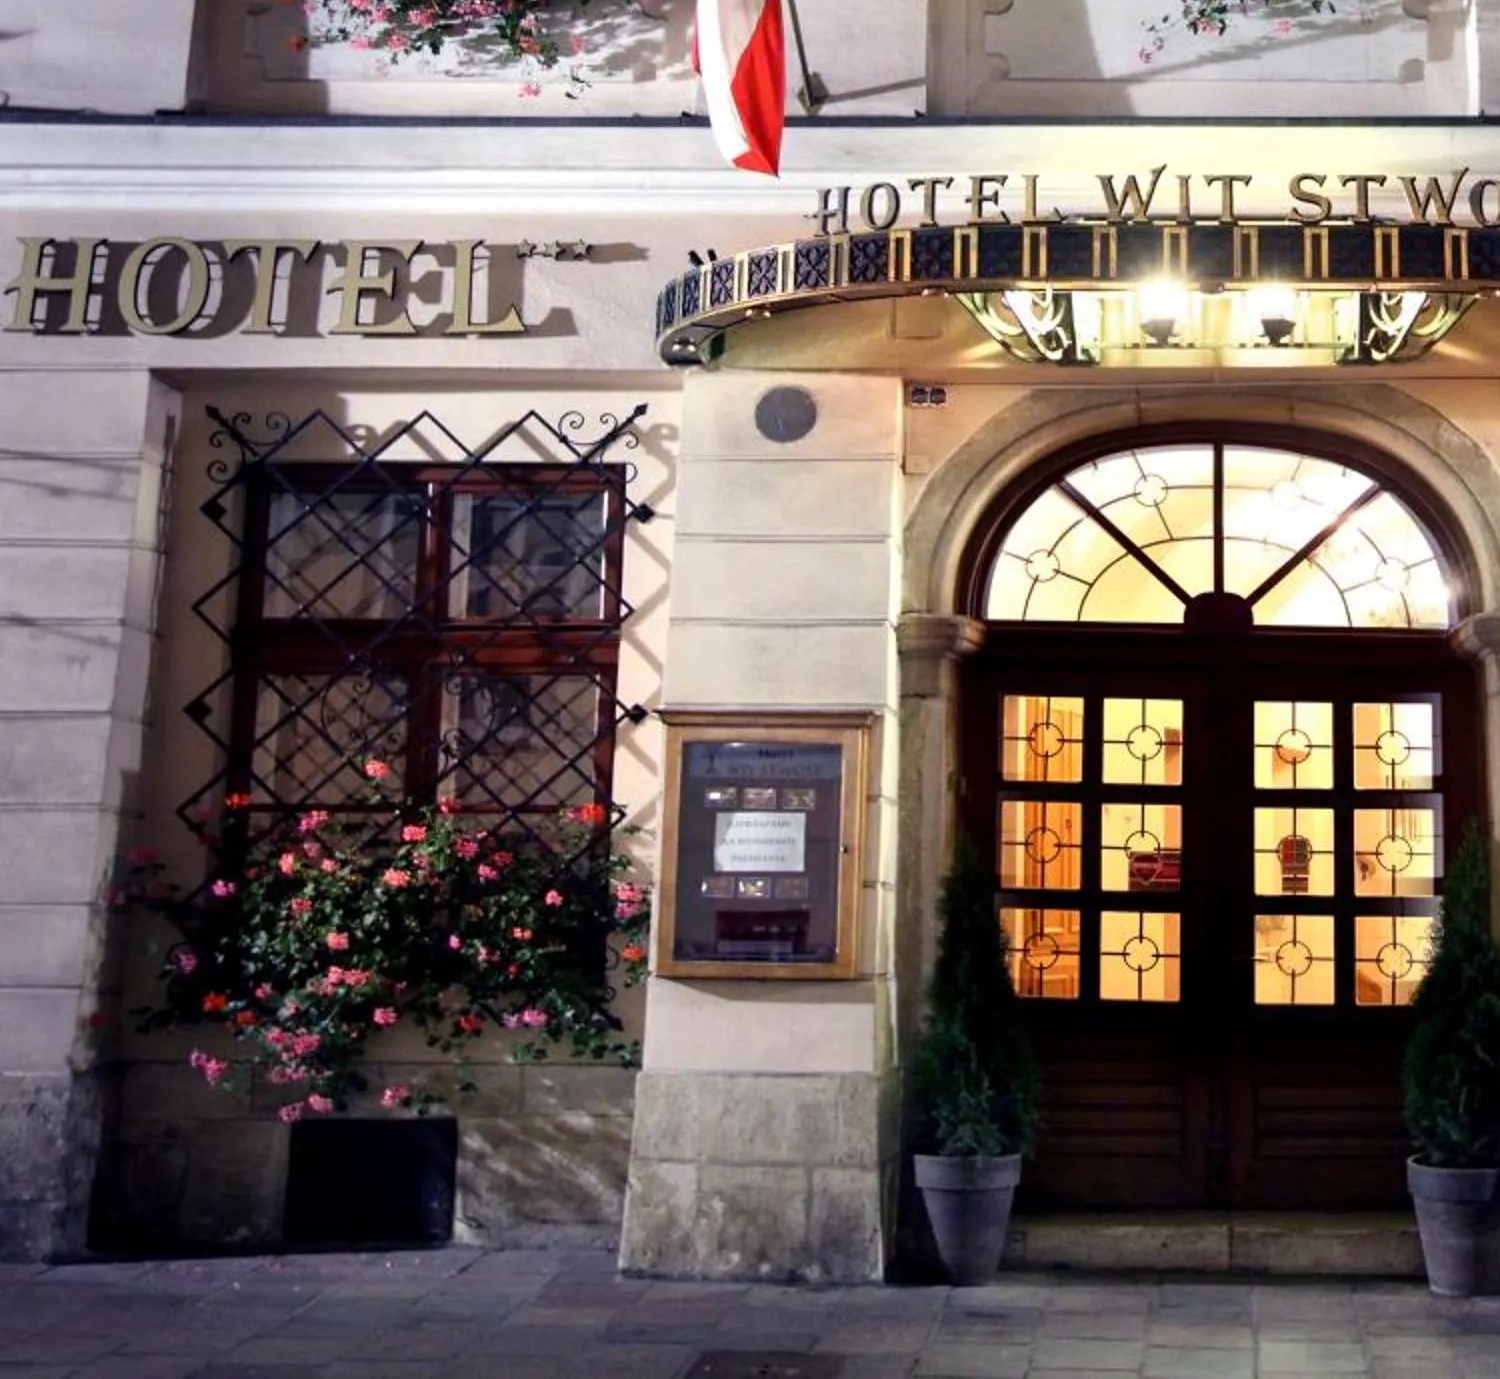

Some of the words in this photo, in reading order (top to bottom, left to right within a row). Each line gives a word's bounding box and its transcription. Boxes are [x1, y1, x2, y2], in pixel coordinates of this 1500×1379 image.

[804, 174, 1063, 237] HOTEL
[1096, 163, 1252, 223] WIT
[3, 236, 526, 337] HOTEL
